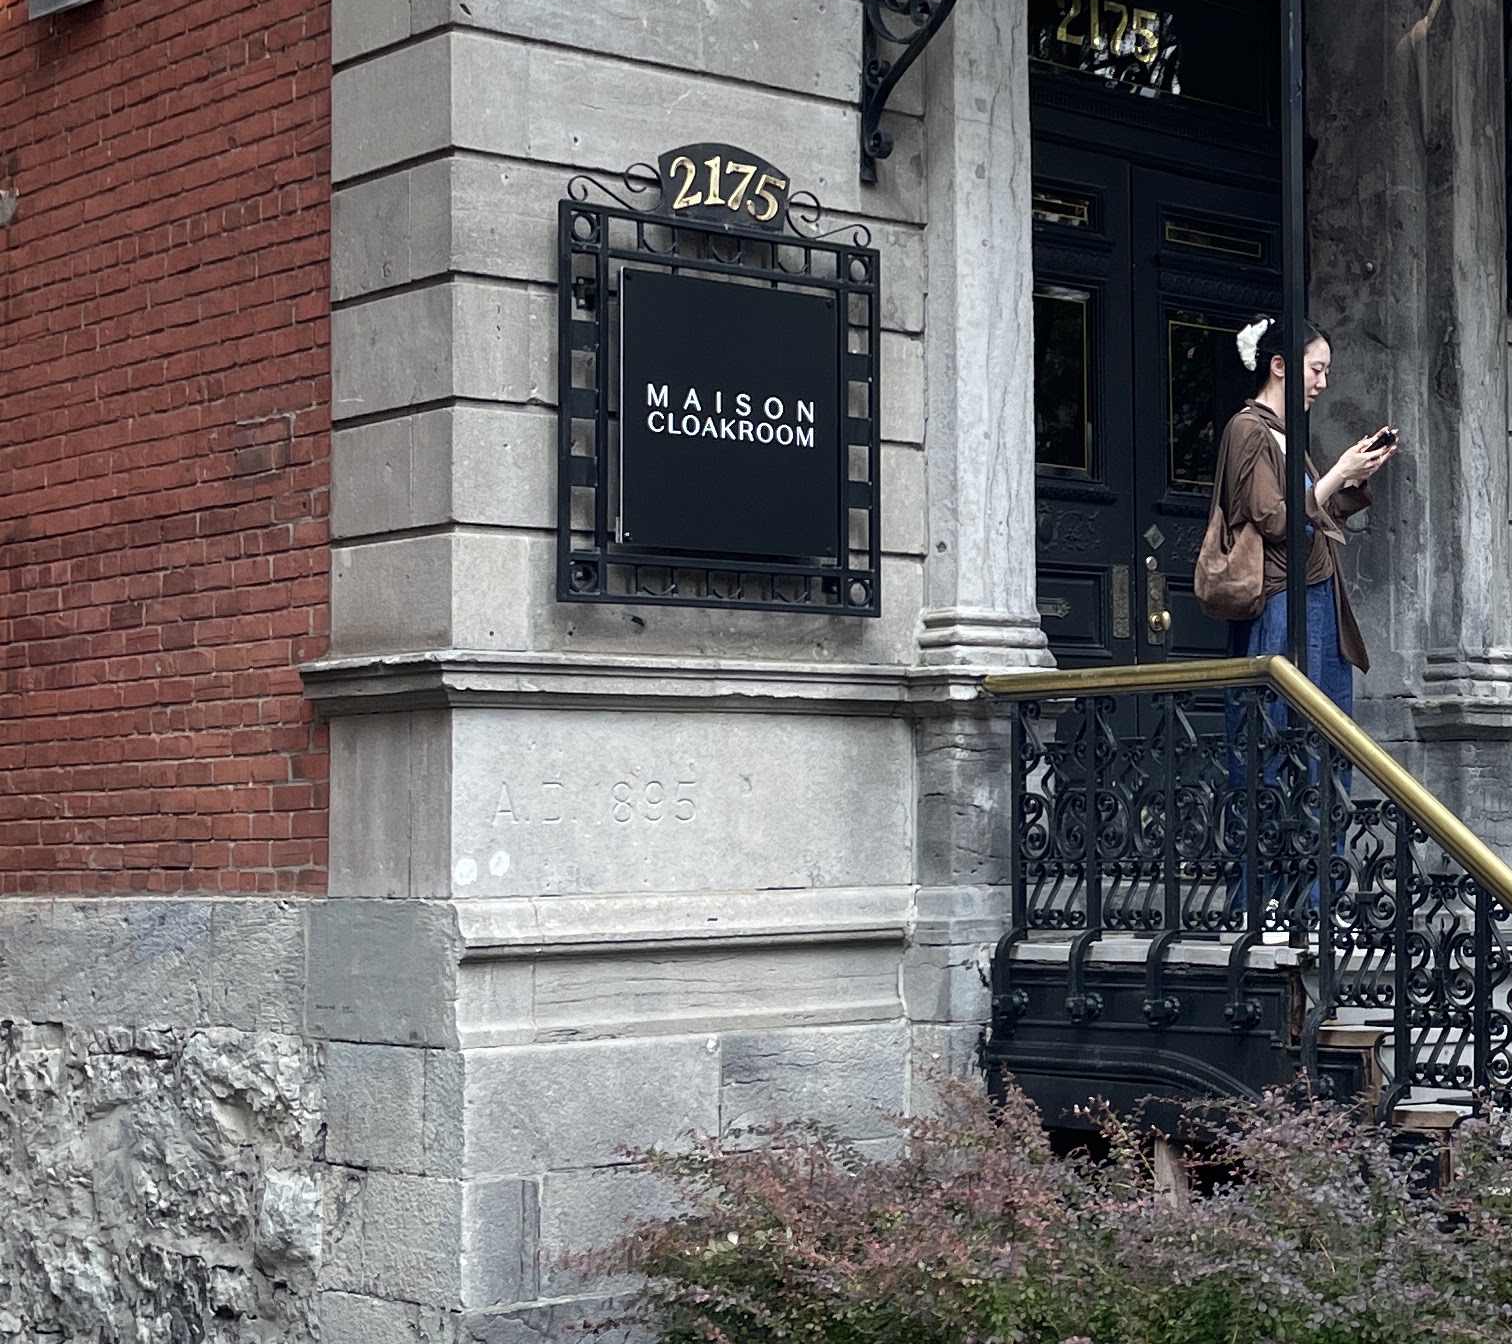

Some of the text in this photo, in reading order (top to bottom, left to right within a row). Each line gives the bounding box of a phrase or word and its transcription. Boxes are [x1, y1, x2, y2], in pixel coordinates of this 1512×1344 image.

[669, 155, 787, 223] 2175
[646, 382, 816, 425] MAISON
[646, 410, 816, 449] CLOAKROOM
